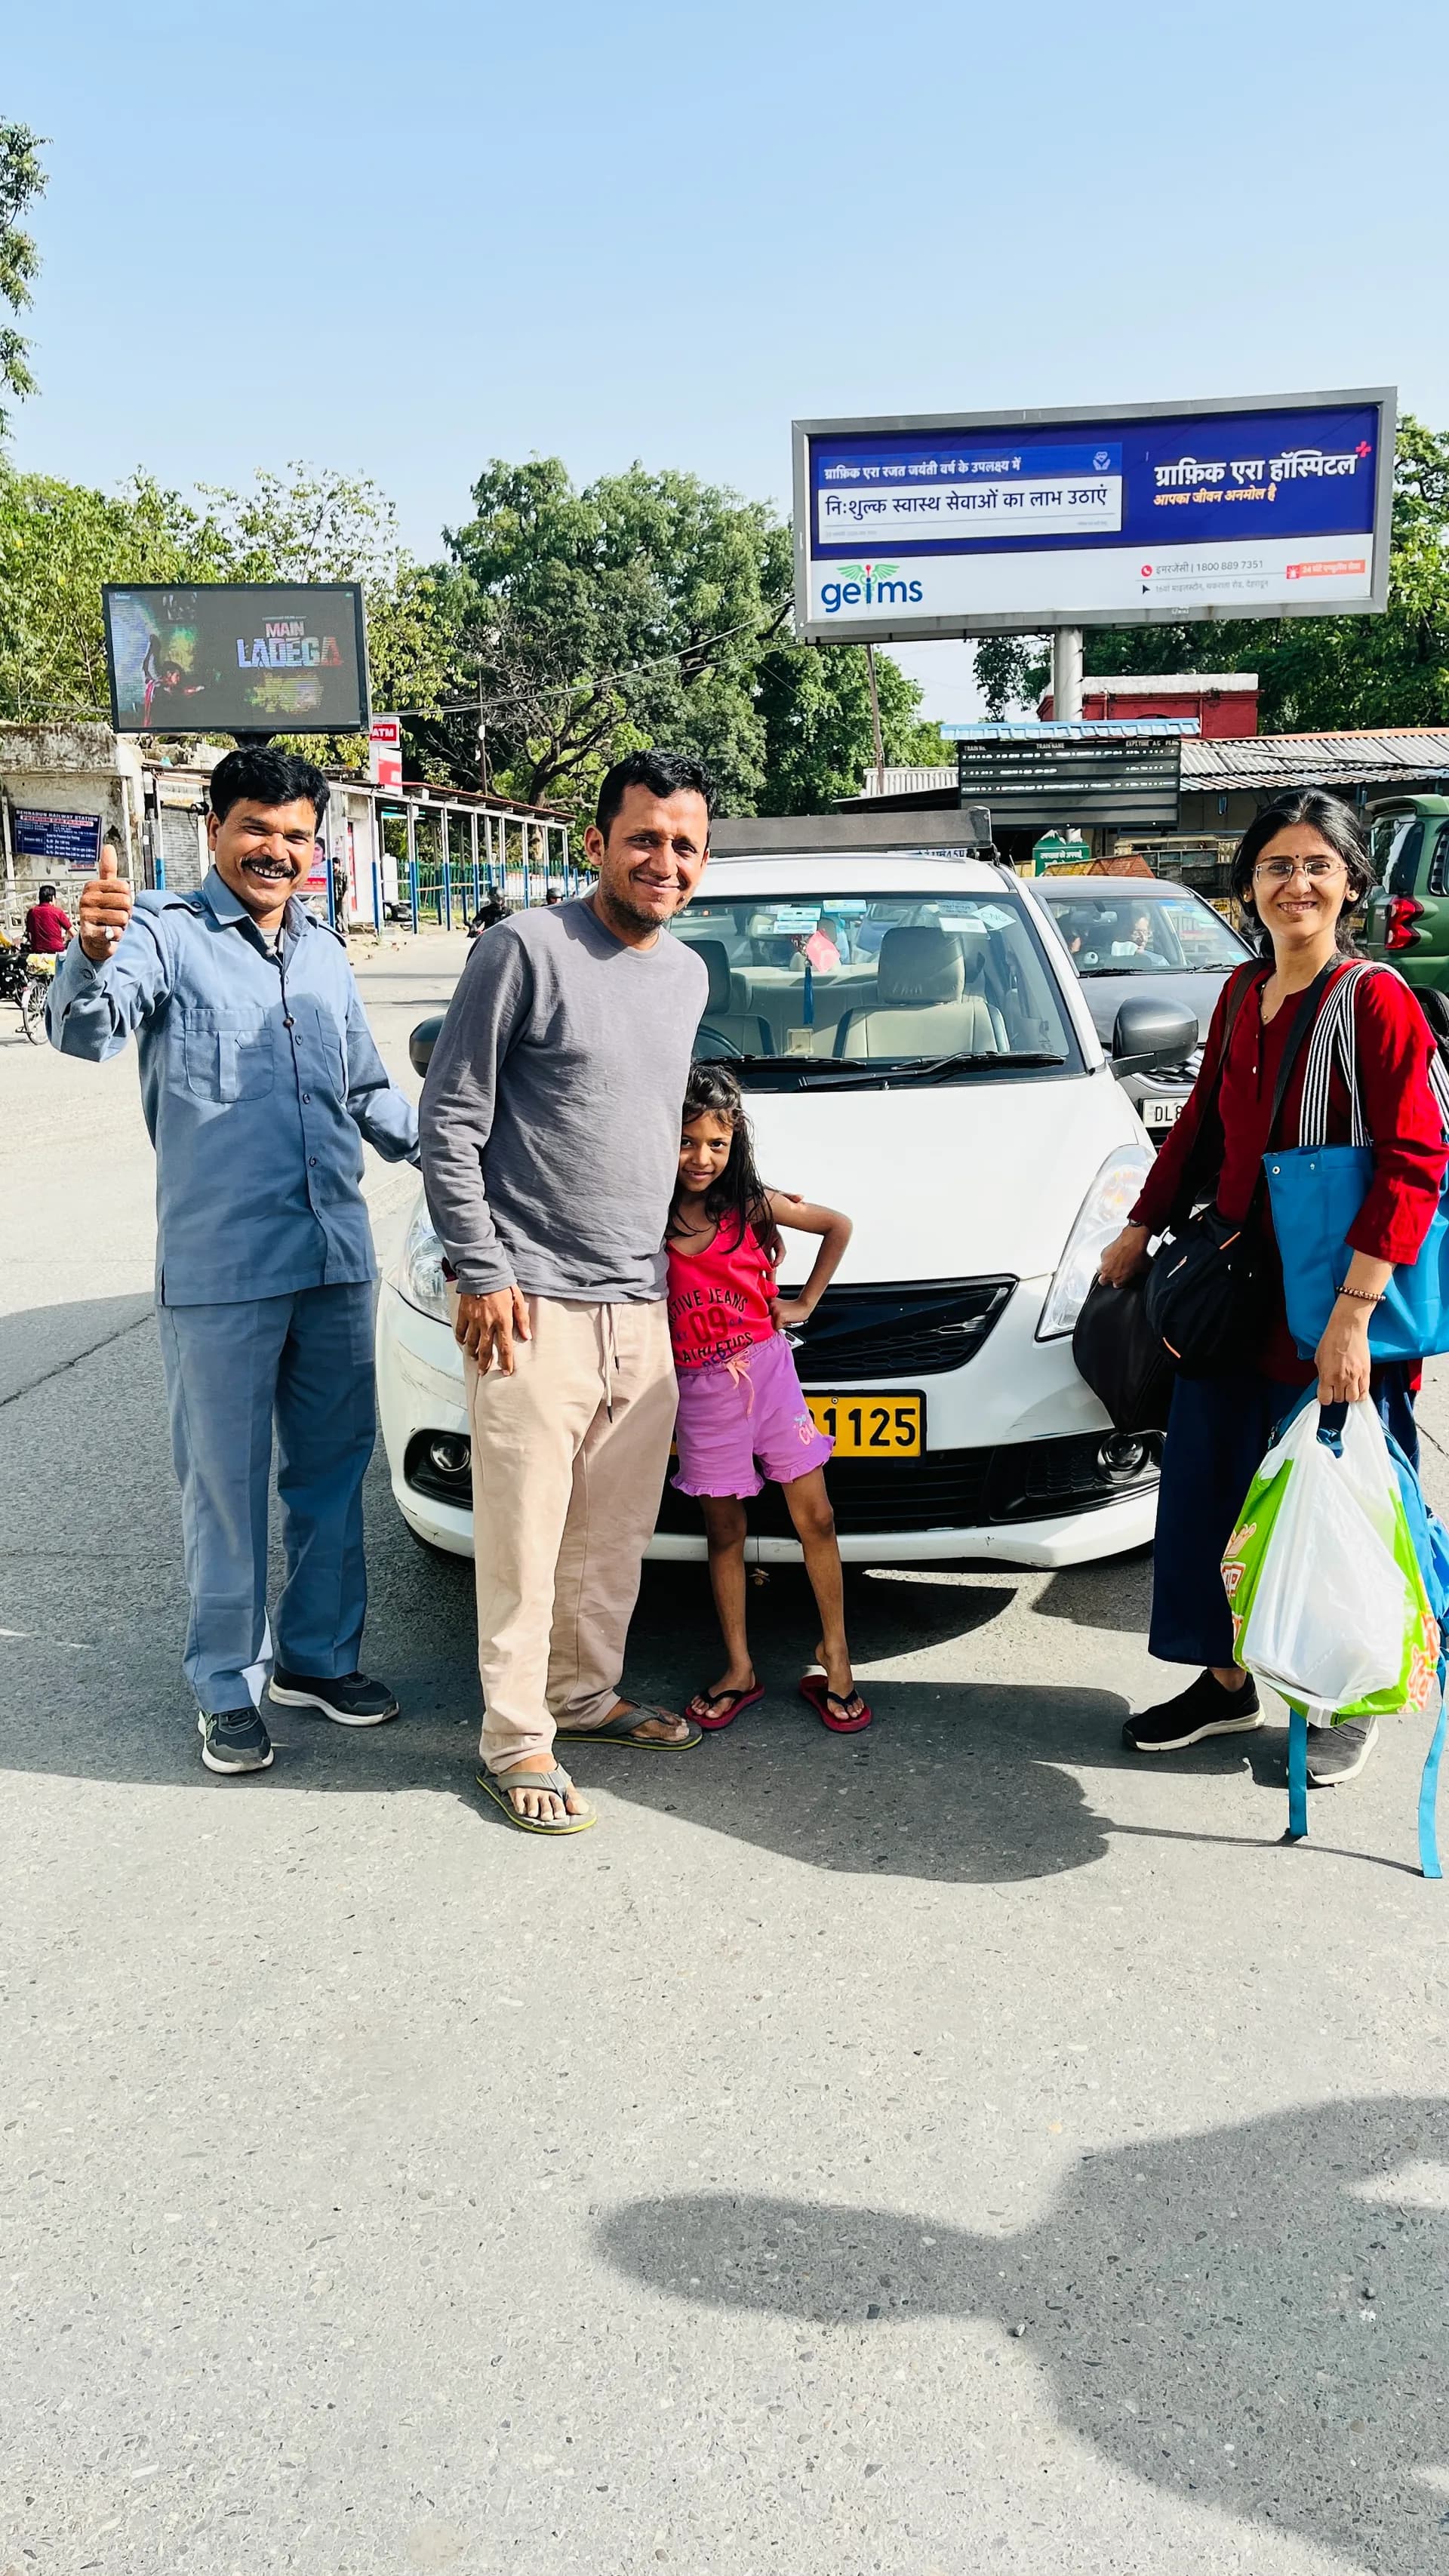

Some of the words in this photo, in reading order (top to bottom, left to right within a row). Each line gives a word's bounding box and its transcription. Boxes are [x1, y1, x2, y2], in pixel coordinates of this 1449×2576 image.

[863, 466, 879, 480] एरा
[882, 465, 906, 478] रजत
[908, 461, 938, 476] जयंती
[940, 460, 955, 475] वर्ष
[957, 460, 969, 473] के
[971, 460, 1010, 474] उपलक्ष्य
[1011, 457, 1022, 471] में
[1154, 457, 1227, 487] ग्राफ़िक
[1229, 460, 1266, 485] एरा
[1269, 449, 1358, 482] हॉस्पिटल
[892, 497, 942, 513] स्वास्थ
[946, 488, 999, 511] सेवाओं
[1002, 492, 1026, 508] का
[1029, 491, 1063, 506] लाभ
[1068, 483, 1108, 506] उठाएं
[1153, 492, 1191, 506] आपका
[1192, 488, 1224, 504] जीवन
[1224, 485, 1266, 502] अनमोल
[1267, 482, 1277, 502] है
[1197, 562, 1220, 571] 1800
[1221, 561, 1239, 570] 889
[1241, 560, 1263, 569] 7351
[821, 577, 923, 613] geims
[266, 621, 305, 637] MAIN
[236, 636, 343, 668] LADEGA
[371, 728, 394, 737] ATM
[709, 1288, 749, 1313] JEANS
[688, 1306, 729, 1343] 09
[681, 1331, 754, 1363] ATHLETICS
[808, 1408, 916, 1447] 1125
